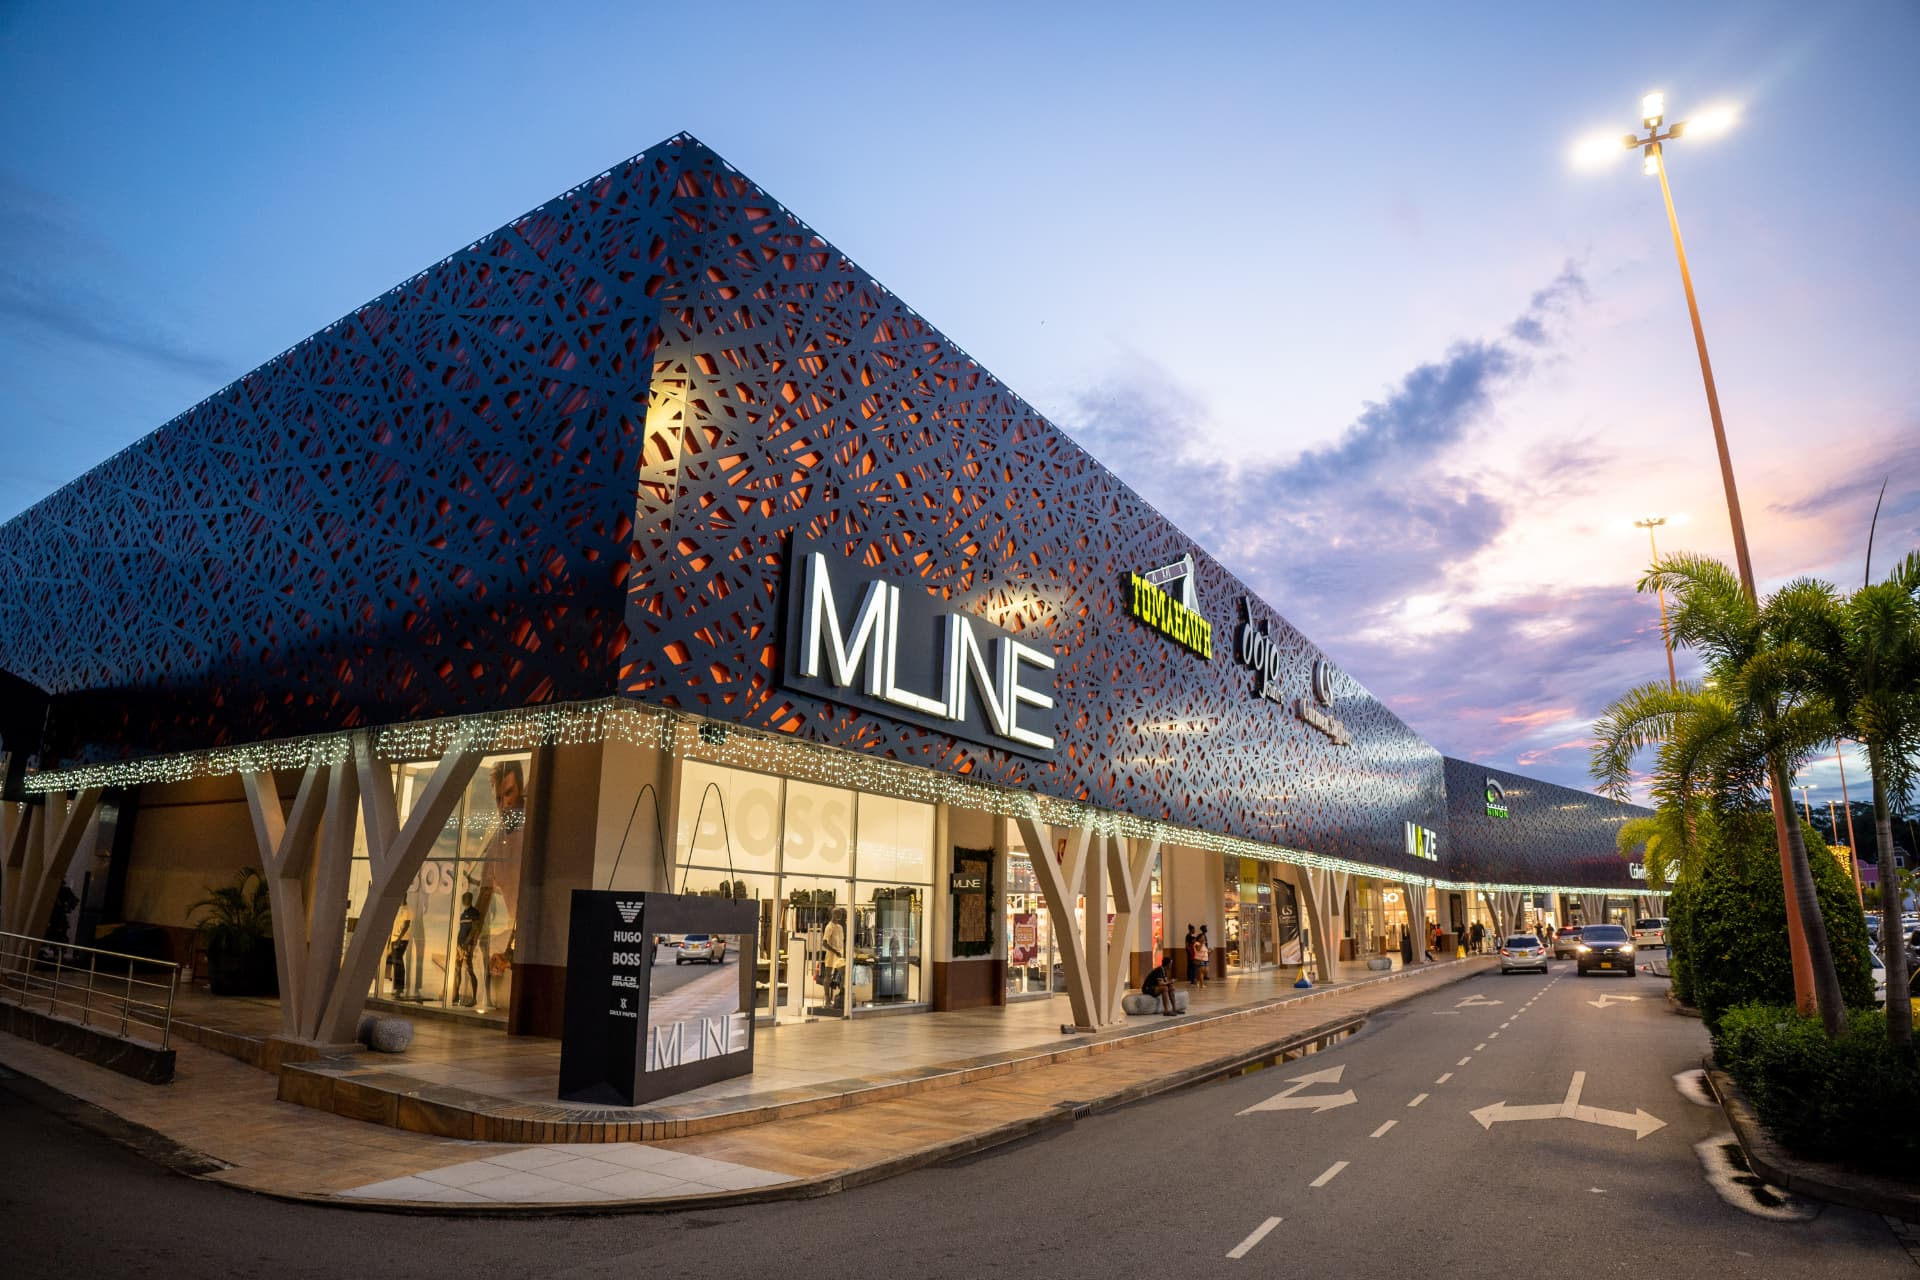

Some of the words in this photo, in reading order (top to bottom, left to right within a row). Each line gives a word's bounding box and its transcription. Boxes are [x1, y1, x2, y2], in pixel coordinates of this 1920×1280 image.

[800, 552, 1055, 749] MLINE
[688, 779, 848, 863] BOSS
[1406, 820, 1438, 862] MAZE
[613, 930, 642, 943] HUGO
[612, 952, 641, 966] BOSS
